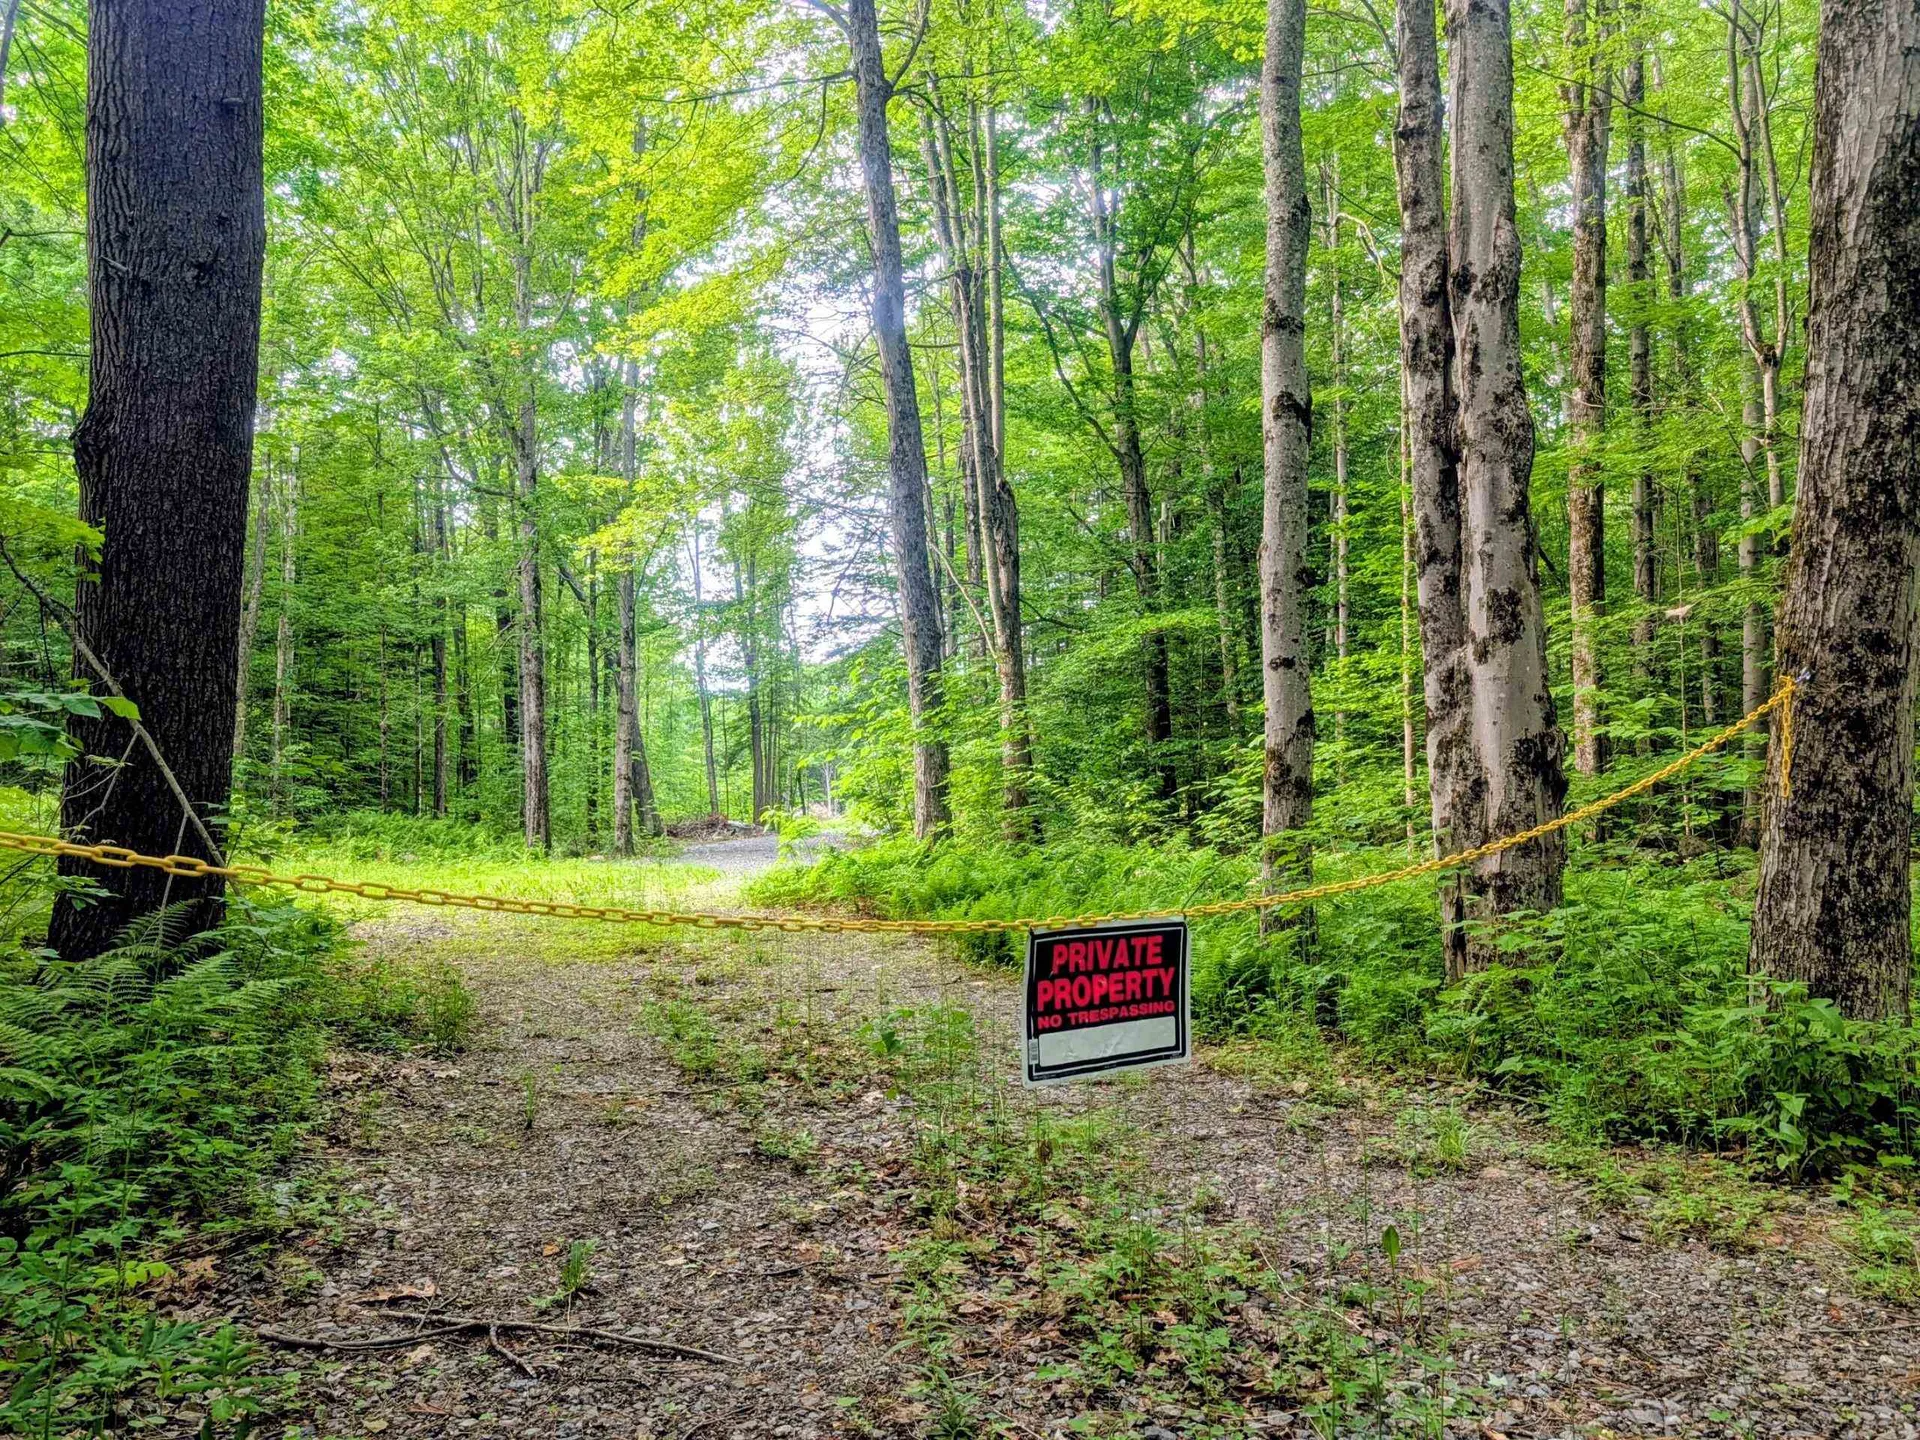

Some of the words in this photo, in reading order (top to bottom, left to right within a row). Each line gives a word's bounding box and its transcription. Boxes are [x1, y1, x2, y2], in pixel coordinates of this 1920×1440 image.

[1053, 935, 1163, 974] PRIVATE
[1037, 967, 1175, 1011] PROPERTY
[1038, 1014, 1062, 1029] NO
[1068, 1000, 1175, 1025] TRESPASSING
